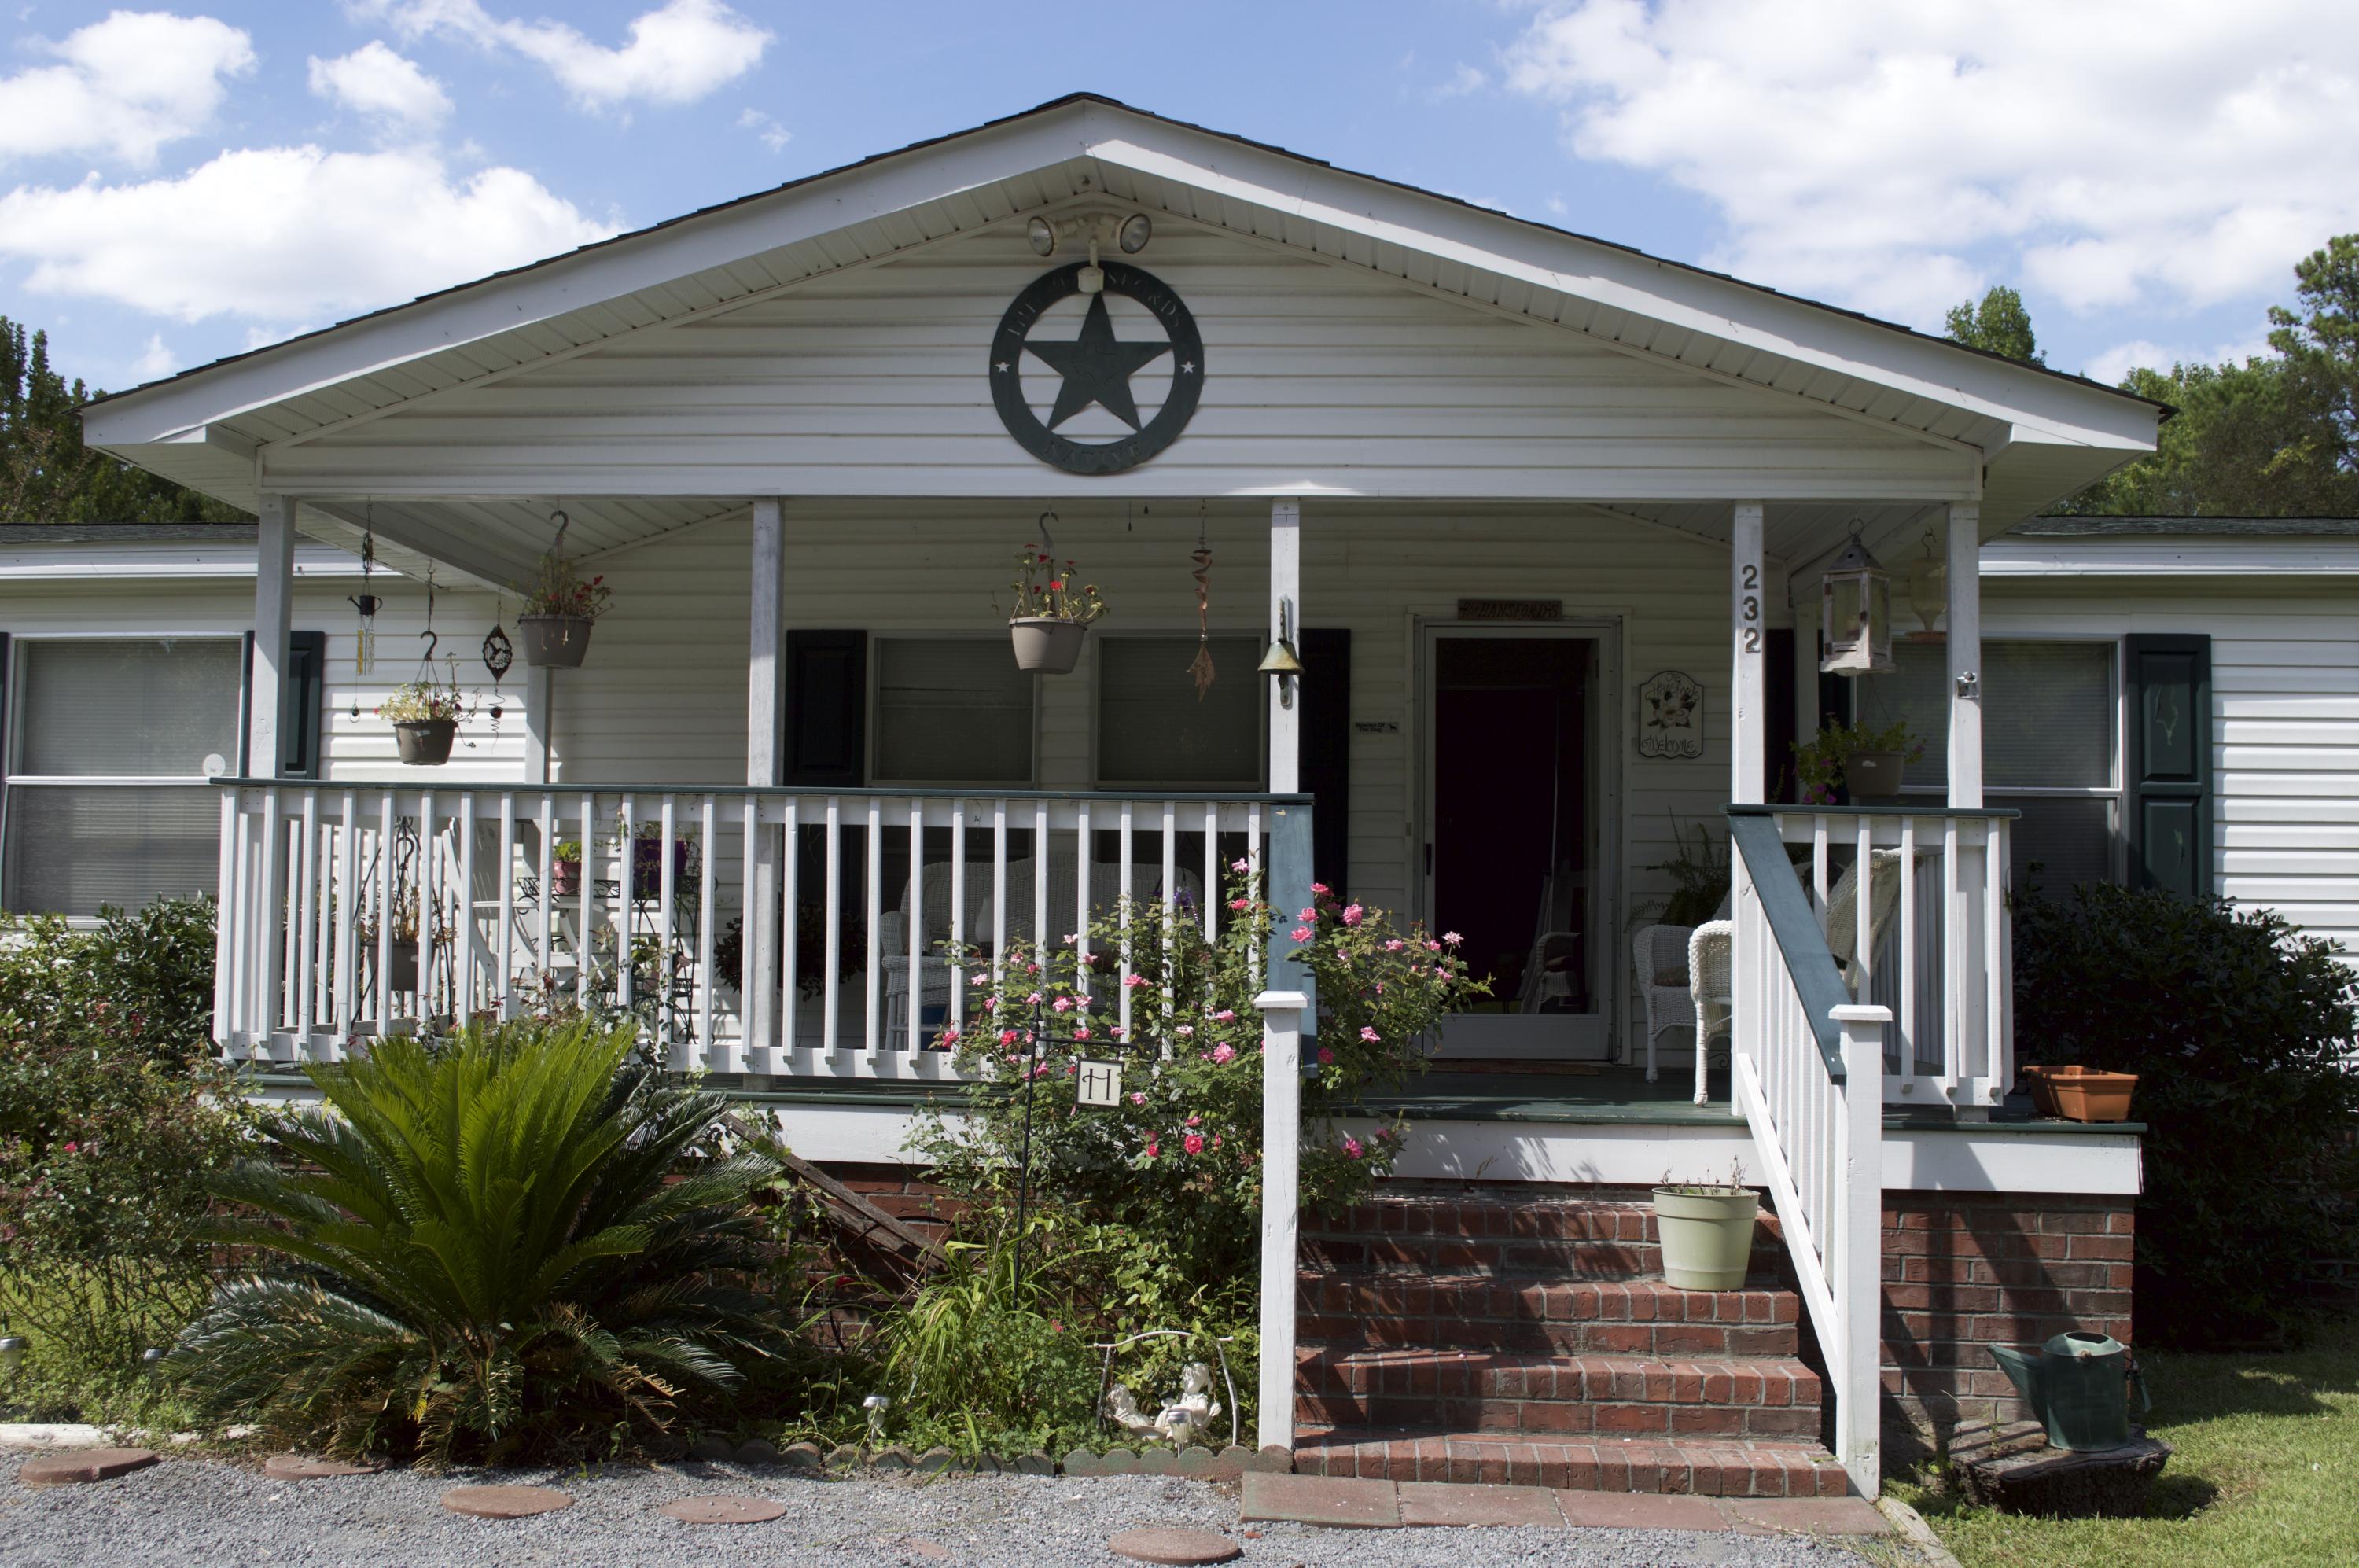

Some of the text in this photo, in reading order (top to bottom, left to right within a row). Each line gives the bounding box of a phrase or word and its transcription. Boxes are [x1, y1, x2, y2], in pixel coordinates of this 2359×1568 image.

[1743, 565, 1761, 653] 232
[1641, 734, 1698, 755] Welcome
[1082, 1068, 1111, 1100] H
